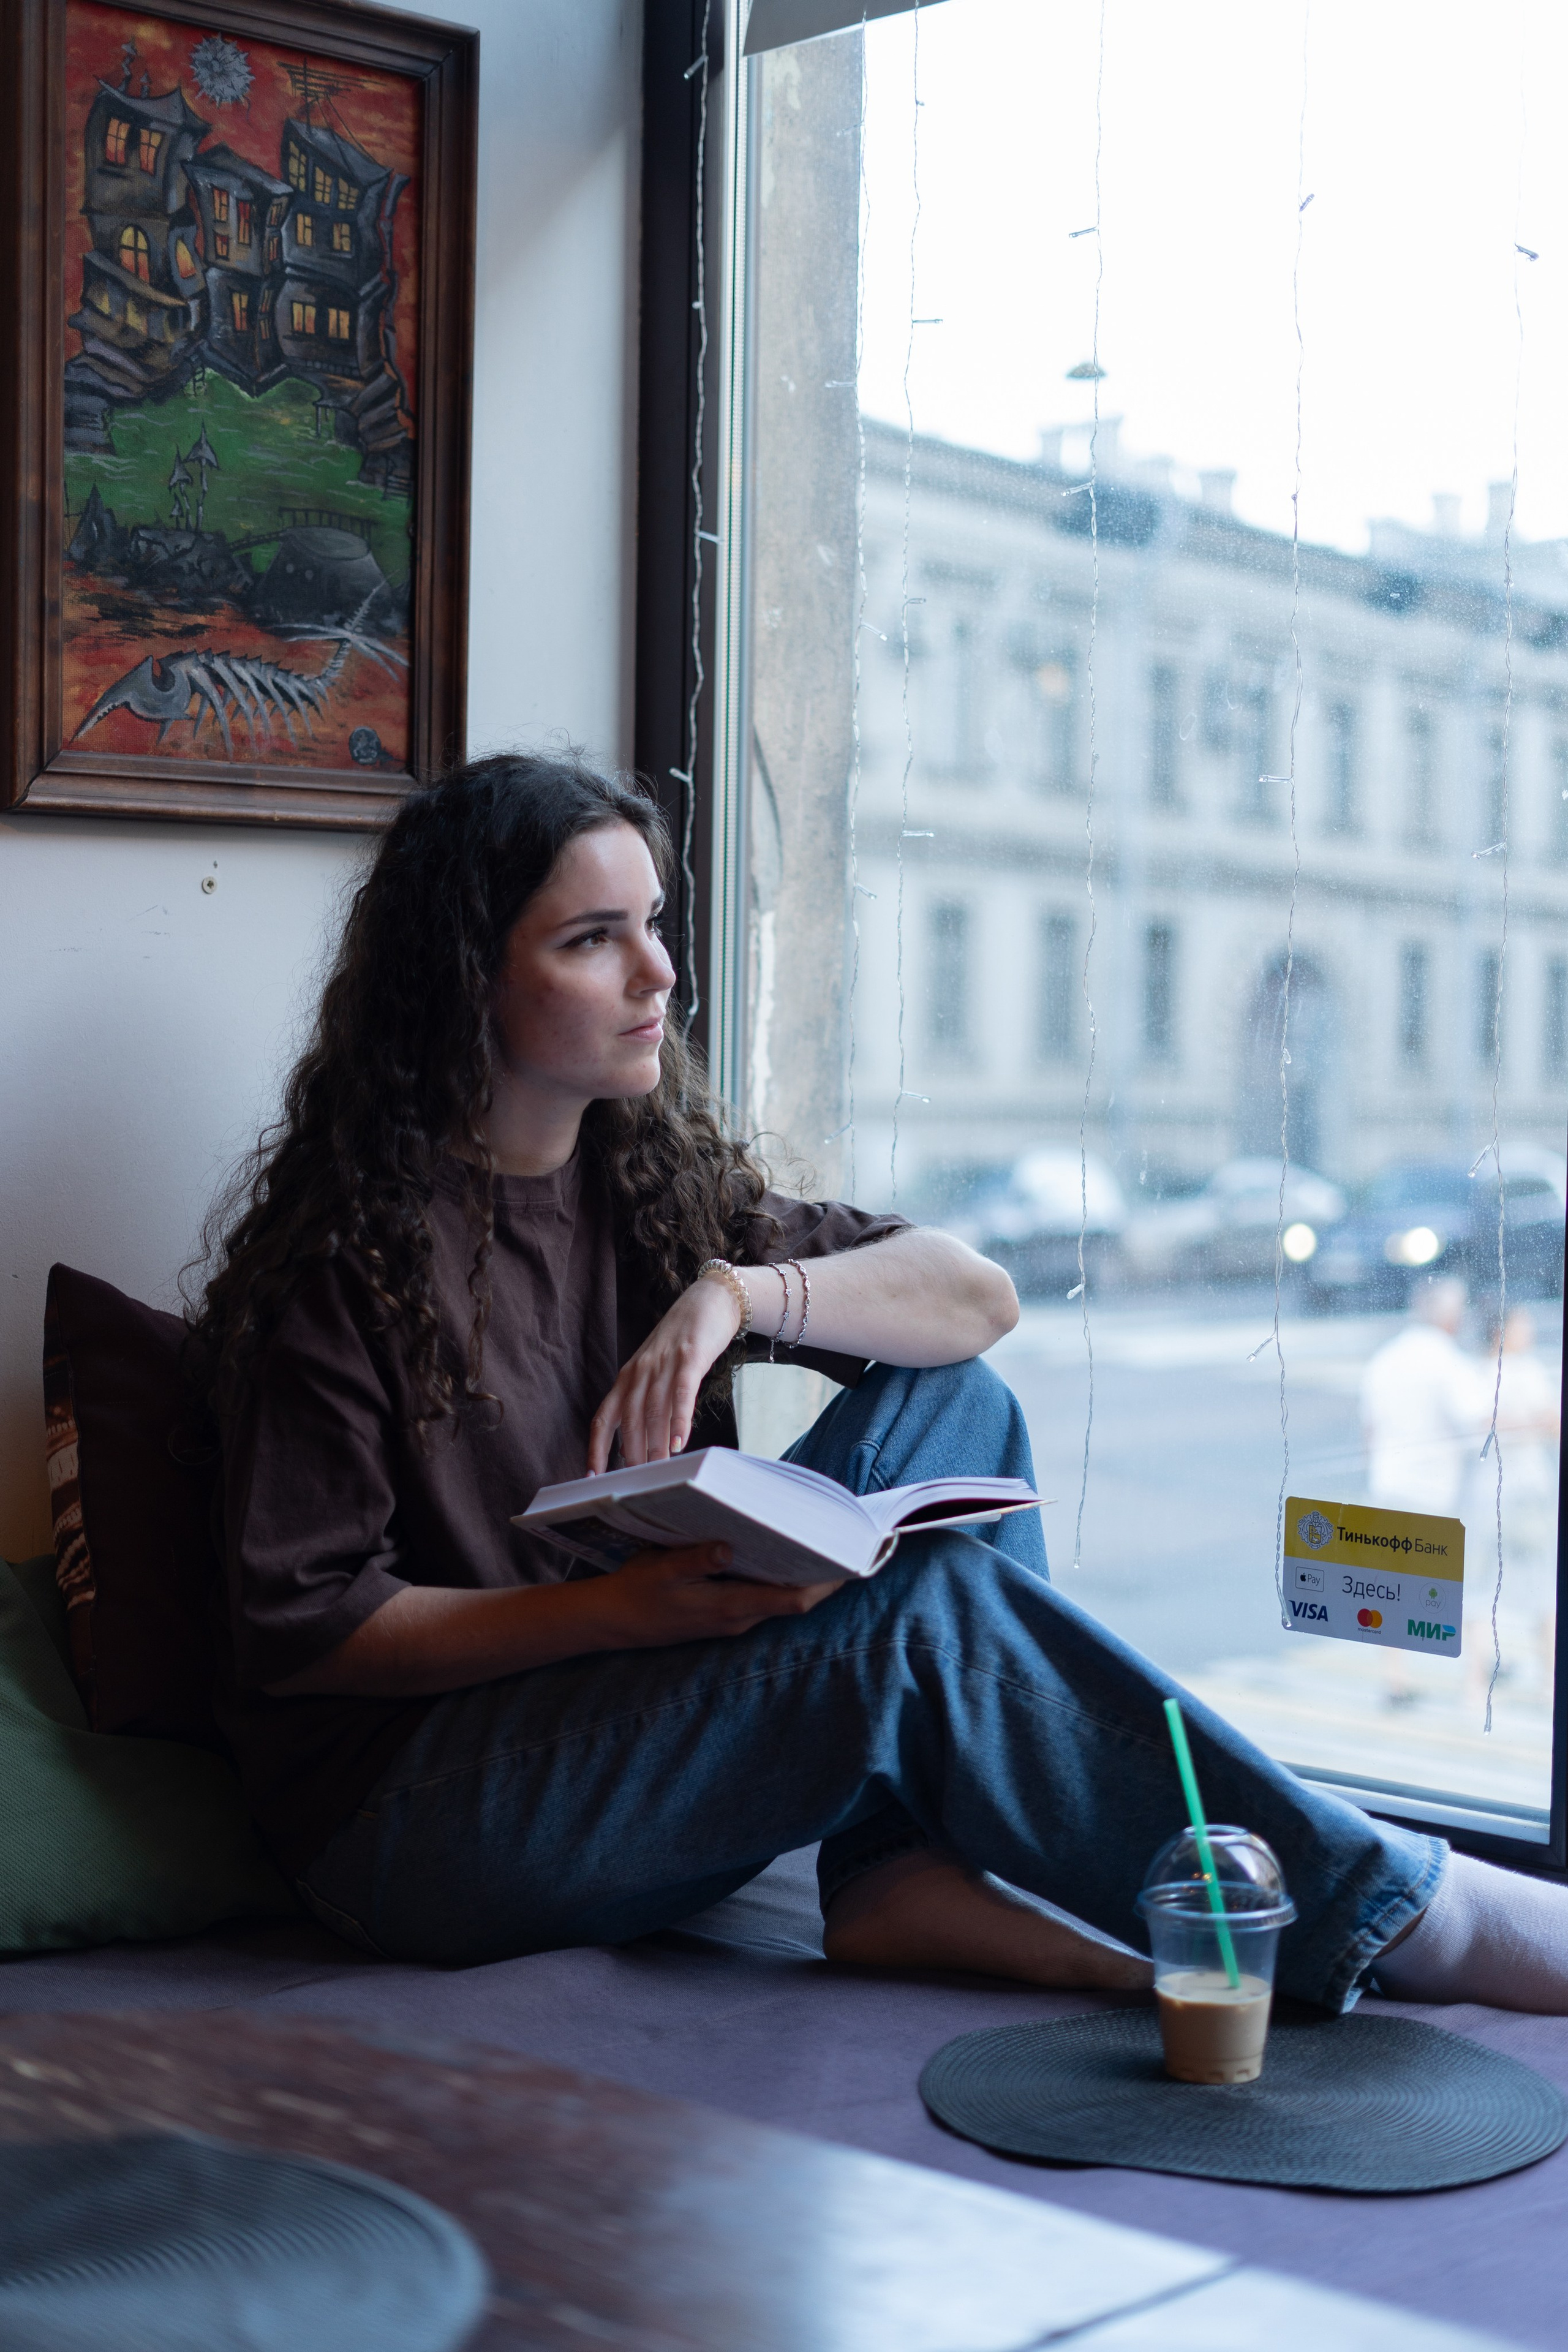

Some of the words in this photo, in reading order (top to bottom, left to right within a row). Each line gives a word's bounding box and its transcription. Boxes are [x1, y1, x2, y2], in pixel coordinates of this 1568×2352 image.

[1337, 1526, 1412, 1554] Тинькофф
[1415, 1539, 1448, 1556] Банк
[1307, 1574, 1321, 1586] Pay
[1342, 1576, 1400, 1601] Здесь!
[1288, 1600, 1329, 1622] VISA
[1425, 1599, 1441, 1608] pay
[1408, 1619, 1456, 1641] МИР
